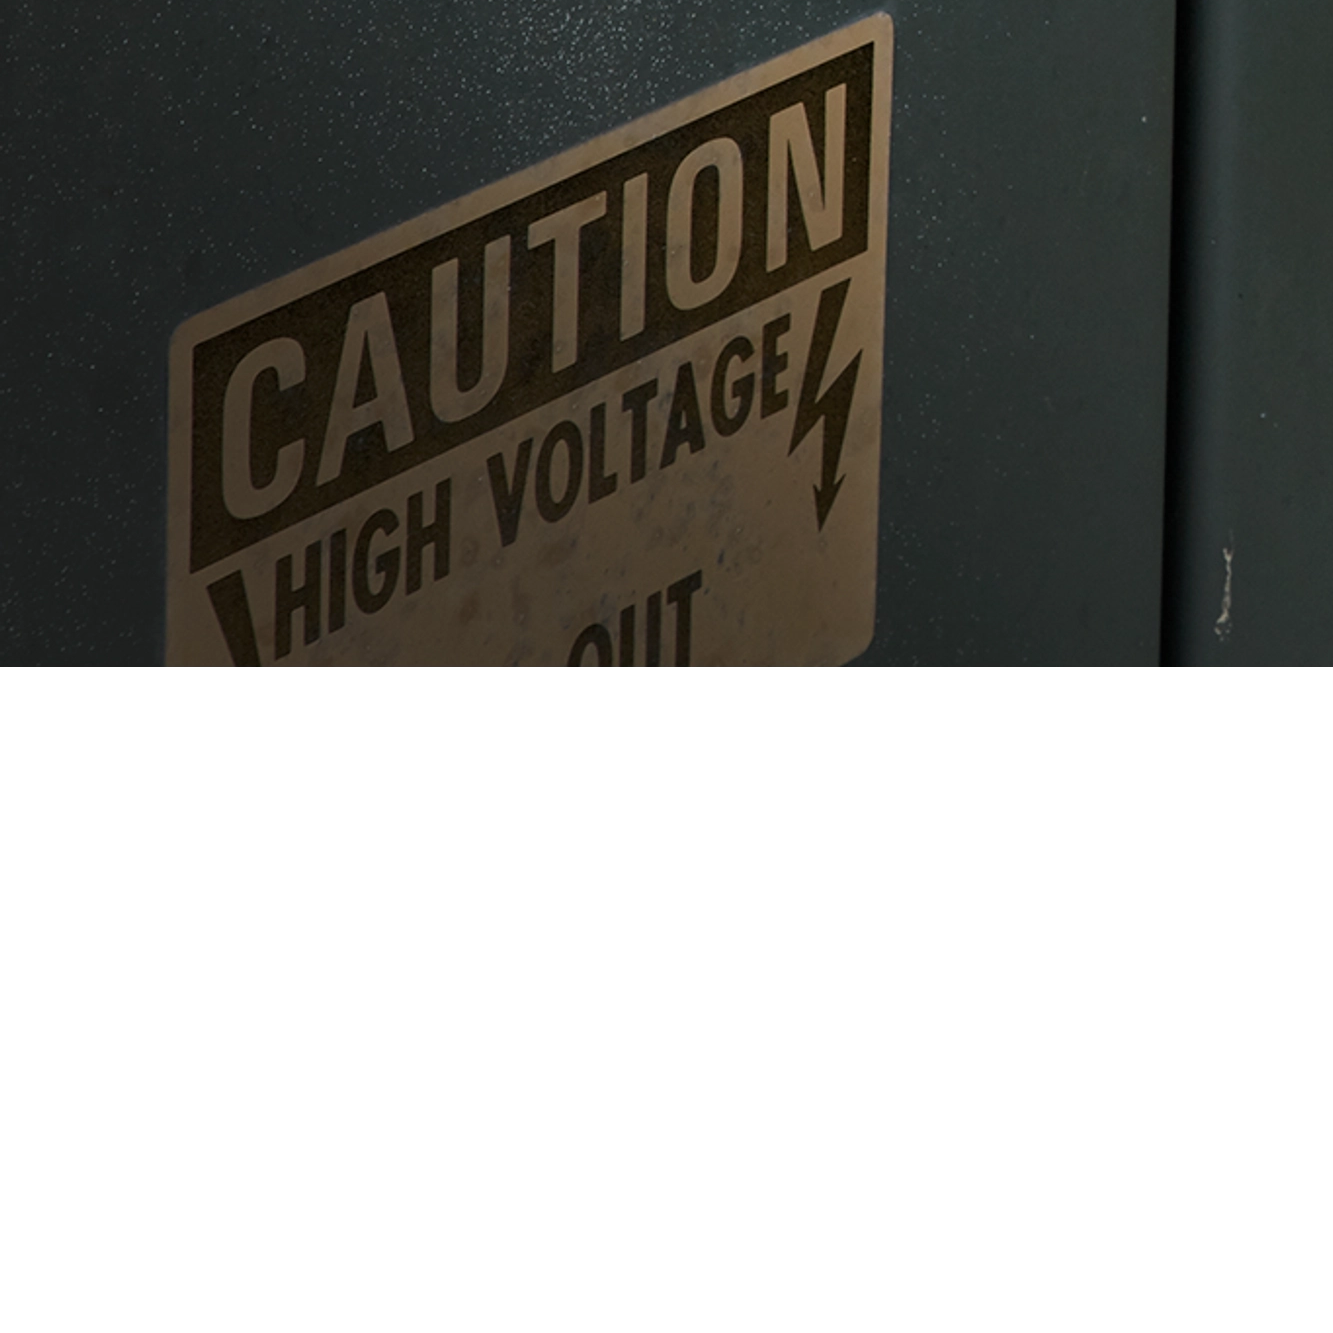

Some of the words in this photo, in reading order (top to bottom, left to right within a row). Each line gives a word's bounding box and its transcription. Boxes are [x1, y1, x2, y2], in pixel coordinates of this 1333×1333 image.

[222, 83, 847, 521] CAUTION
[274, 478, 453, 661] HIGH
[486, 312, 793, 549] VOLTAGE
